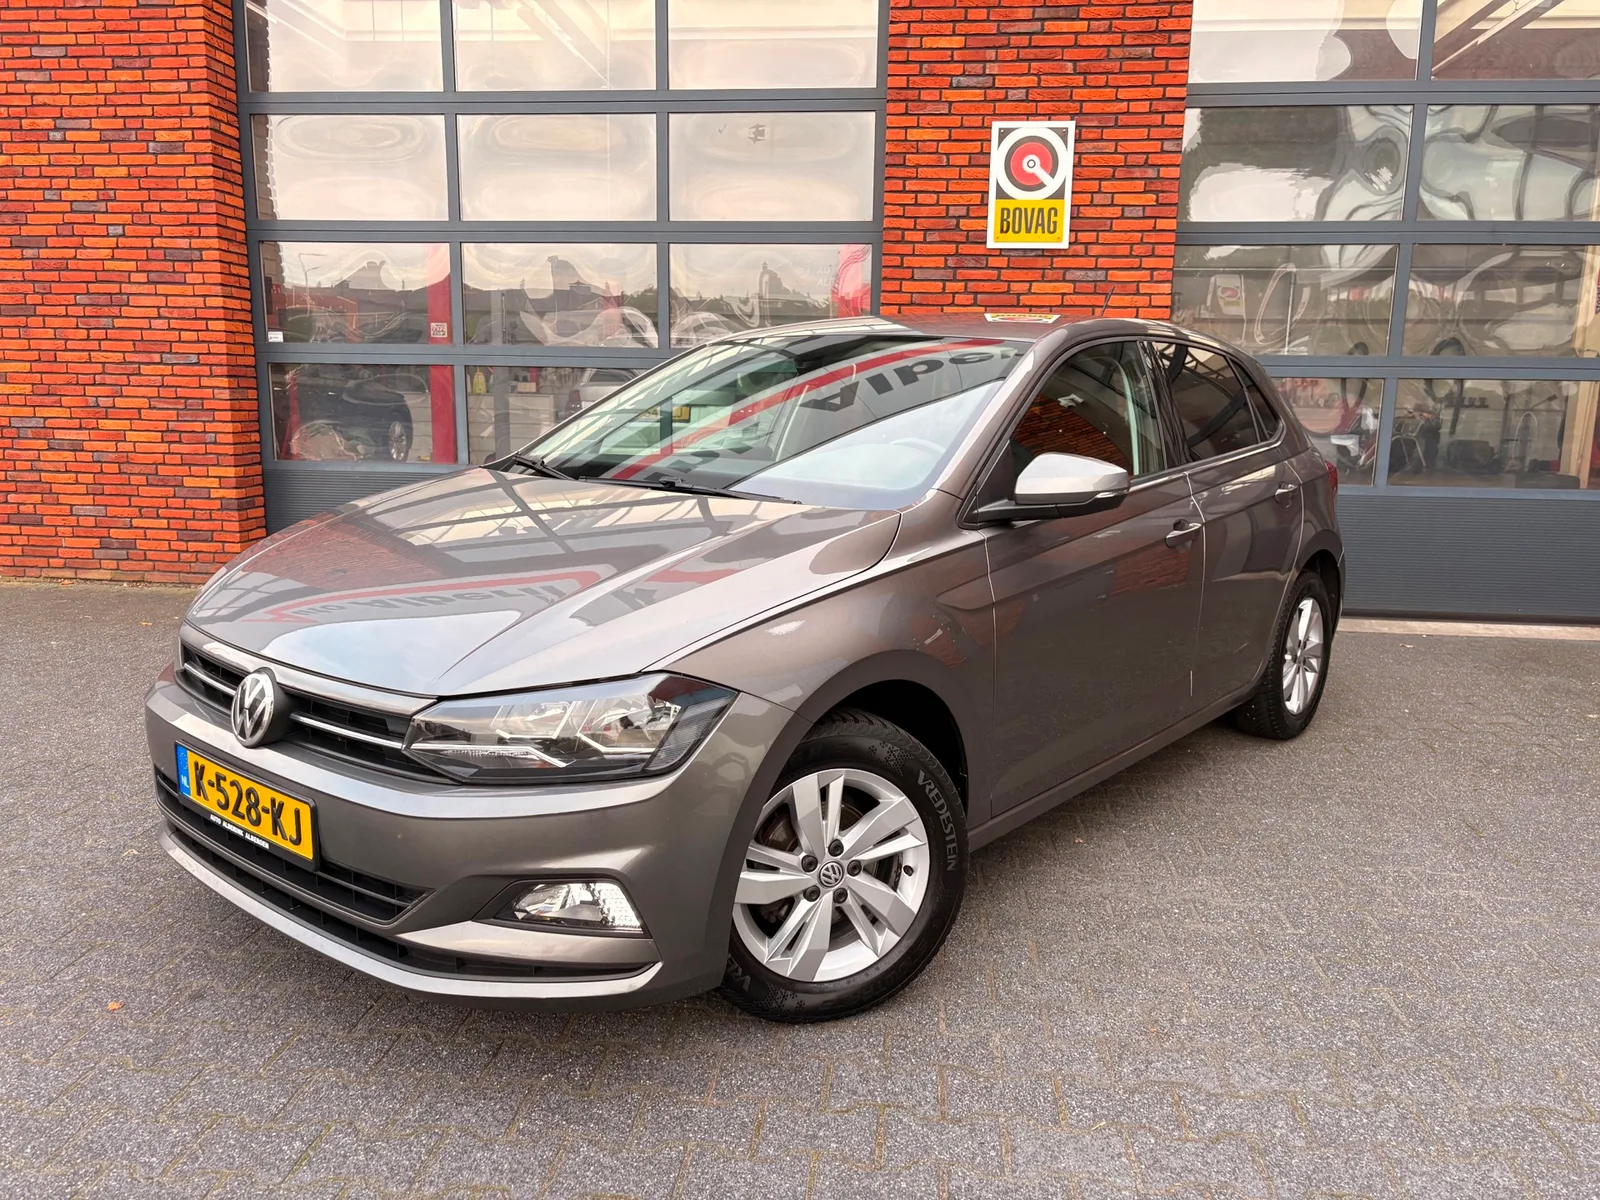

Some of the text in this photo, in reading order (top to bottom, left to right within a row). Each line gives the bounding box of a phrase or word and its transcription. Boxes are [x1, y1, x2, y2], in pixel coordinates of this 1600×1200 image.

[1000, 207, 1058, 235] BOVAG
[181, 774, 190, 789] NL
[194, 760, 302, 846] K-528-KJ
[917, 769, 959, 871] VREDESTEIN
